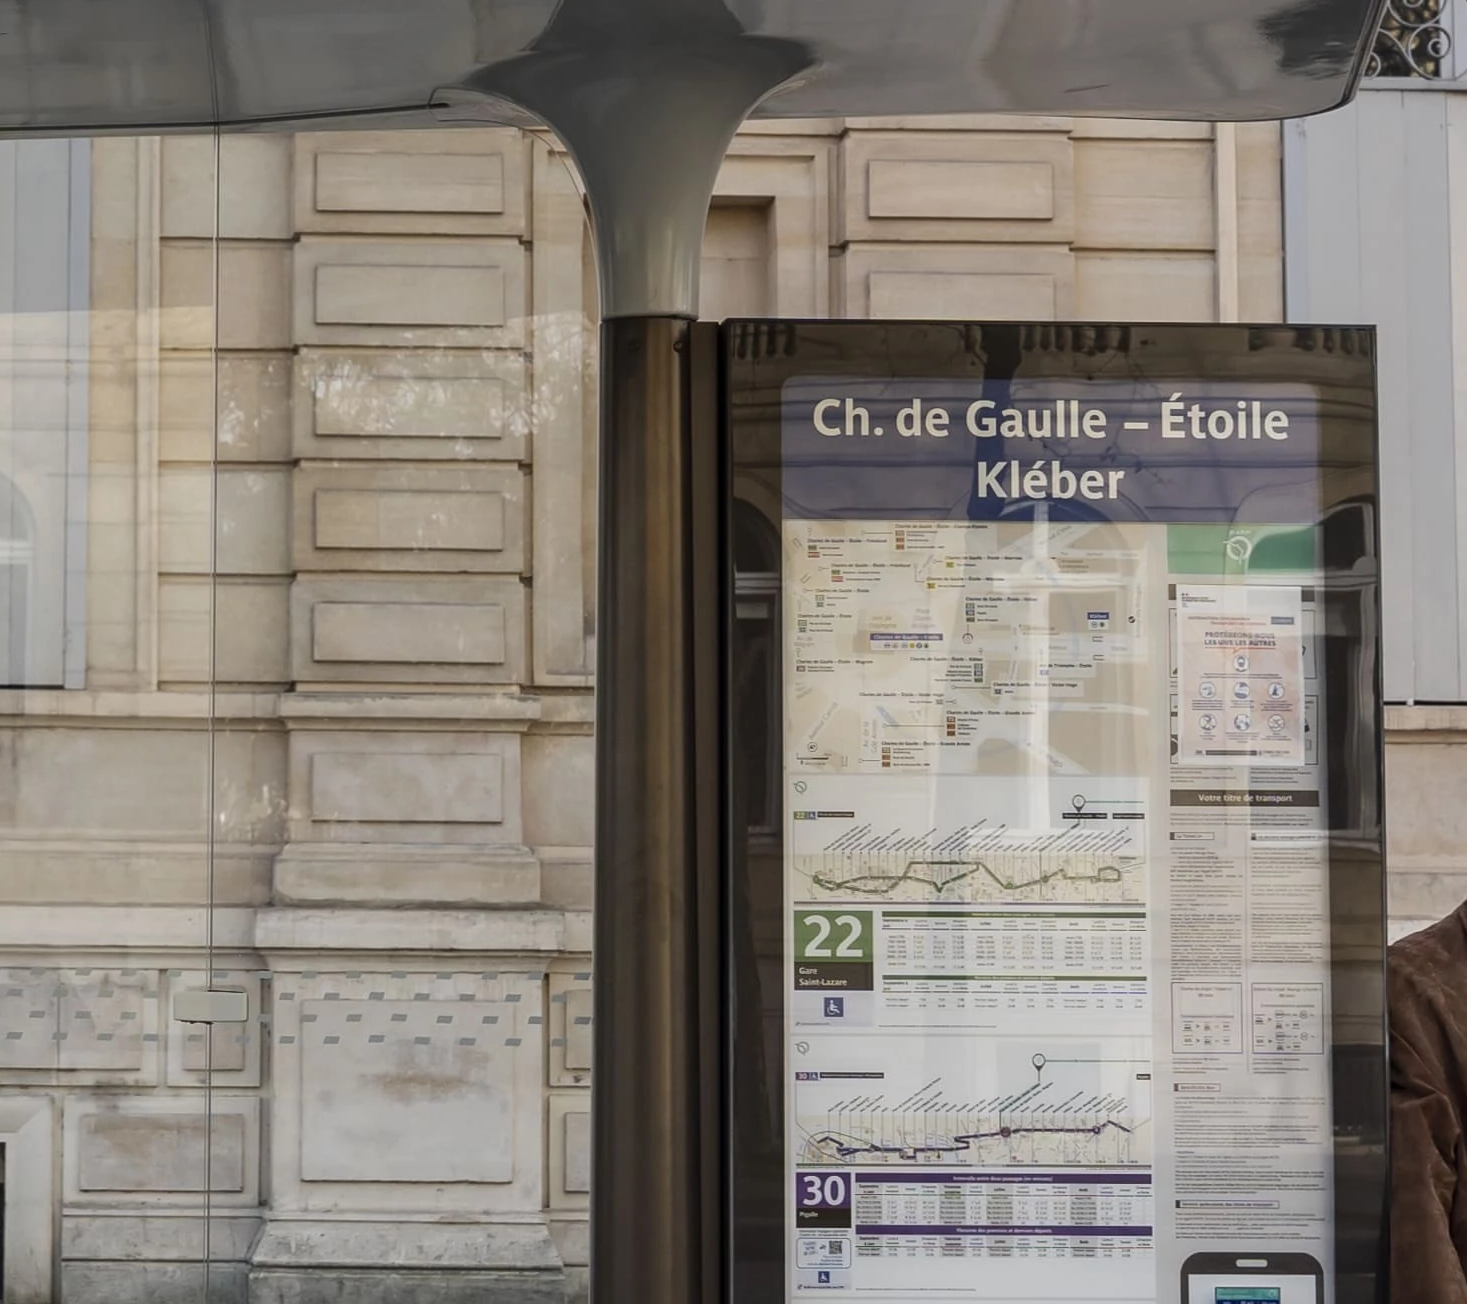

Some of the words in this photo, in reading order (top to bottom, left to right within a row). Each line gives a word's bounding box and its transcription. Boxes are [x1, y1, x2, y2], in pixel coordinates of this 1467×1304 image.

[812, 398, 885, 439] Ch.
[895, 398, 951, 438] de
[966, 399, 1107, 440] Gaulle
[1160, 392, 1290, 441] Étoile
[977, 459, 1126, 499] Kléber
[1198, 794, 1222, 802] Votre
[1223, 794, 1242, 802] titre
[1243, 794, 1254, 802] de
[1255, 794, 1294, 804] transport
[802, 914, 864, 958] 22
[799, 966, 818, 975] Gare
[799, 978, 848, 987] Saint-Lazare
[802, 1175, 846, 1207] 30
